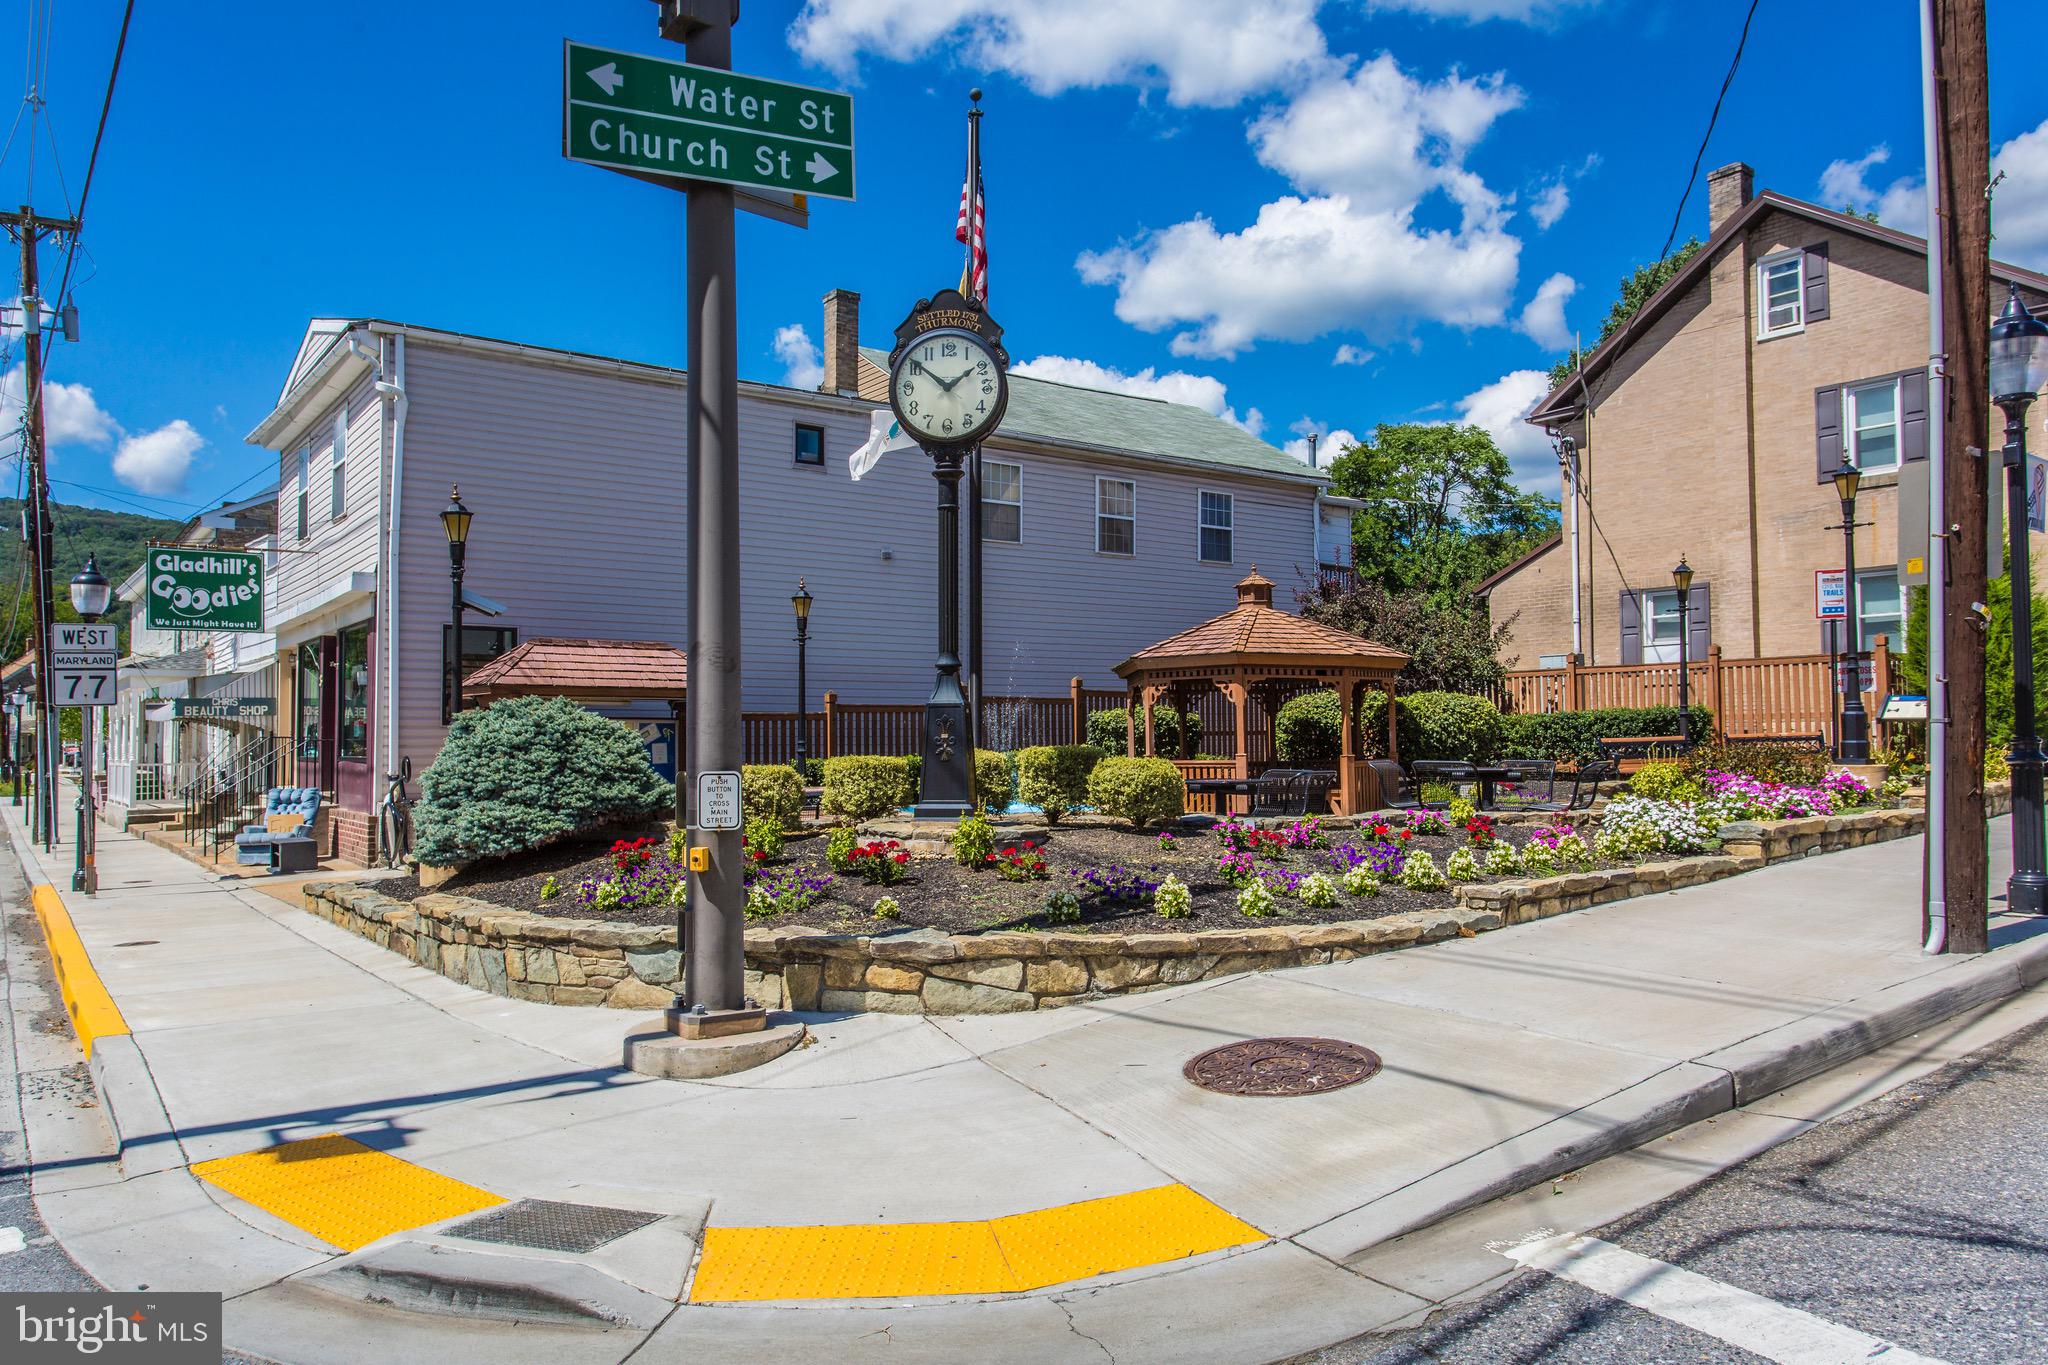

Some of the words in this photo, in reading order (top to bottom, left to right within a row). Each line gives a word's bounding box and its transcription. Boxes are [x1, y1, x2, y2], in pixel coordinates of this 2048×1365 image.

[669, 74, 777, 122] Water
[798, 99, 835, 134] St
[589, 119, 728, 170] Church
[753, 145, 792, 180] St
[917, 309, 960, 324] SETTLED
[962, 311, 979, 322] 1751
[915, 317, 982, 333] THURMONT
[924, 346, 934, 361] 11
[941, 341, 957, 357] 12
[965, 346, 969, 361] 1
[976, 360, 988, 376] 2
[903, 380, 914, 396] 9
[982, 378, 993, 395] 3
[909, 400, 918, 416] 8
[975, 399, 986, 414] 4
[923, 414, 934, 430] 7
[942, 418, 953, 434] 6
[962, 413, 973, 429] 5
[155, 554, 257, 576] Gladhill's
[151, 574, 260, 611] Goodies
[155, 618, 170, 626] We
[172, 619, 190, 627] Just
[192, 619, 219, 628] Might
[221, 620, 245, 628] Have
[247, 621, 257, 629] It!
[62, 630, 108, 645] WEST
[56, 656, 113, 665] MARYLAND
[63, 675, 108, 699] 77
[211, 697, 242, 707] CHRIS'
[184, 705, 229, 716] BEAUTY
[239, 705, 269, 716] SHOP
[706, 816, 732, 824] STREET
